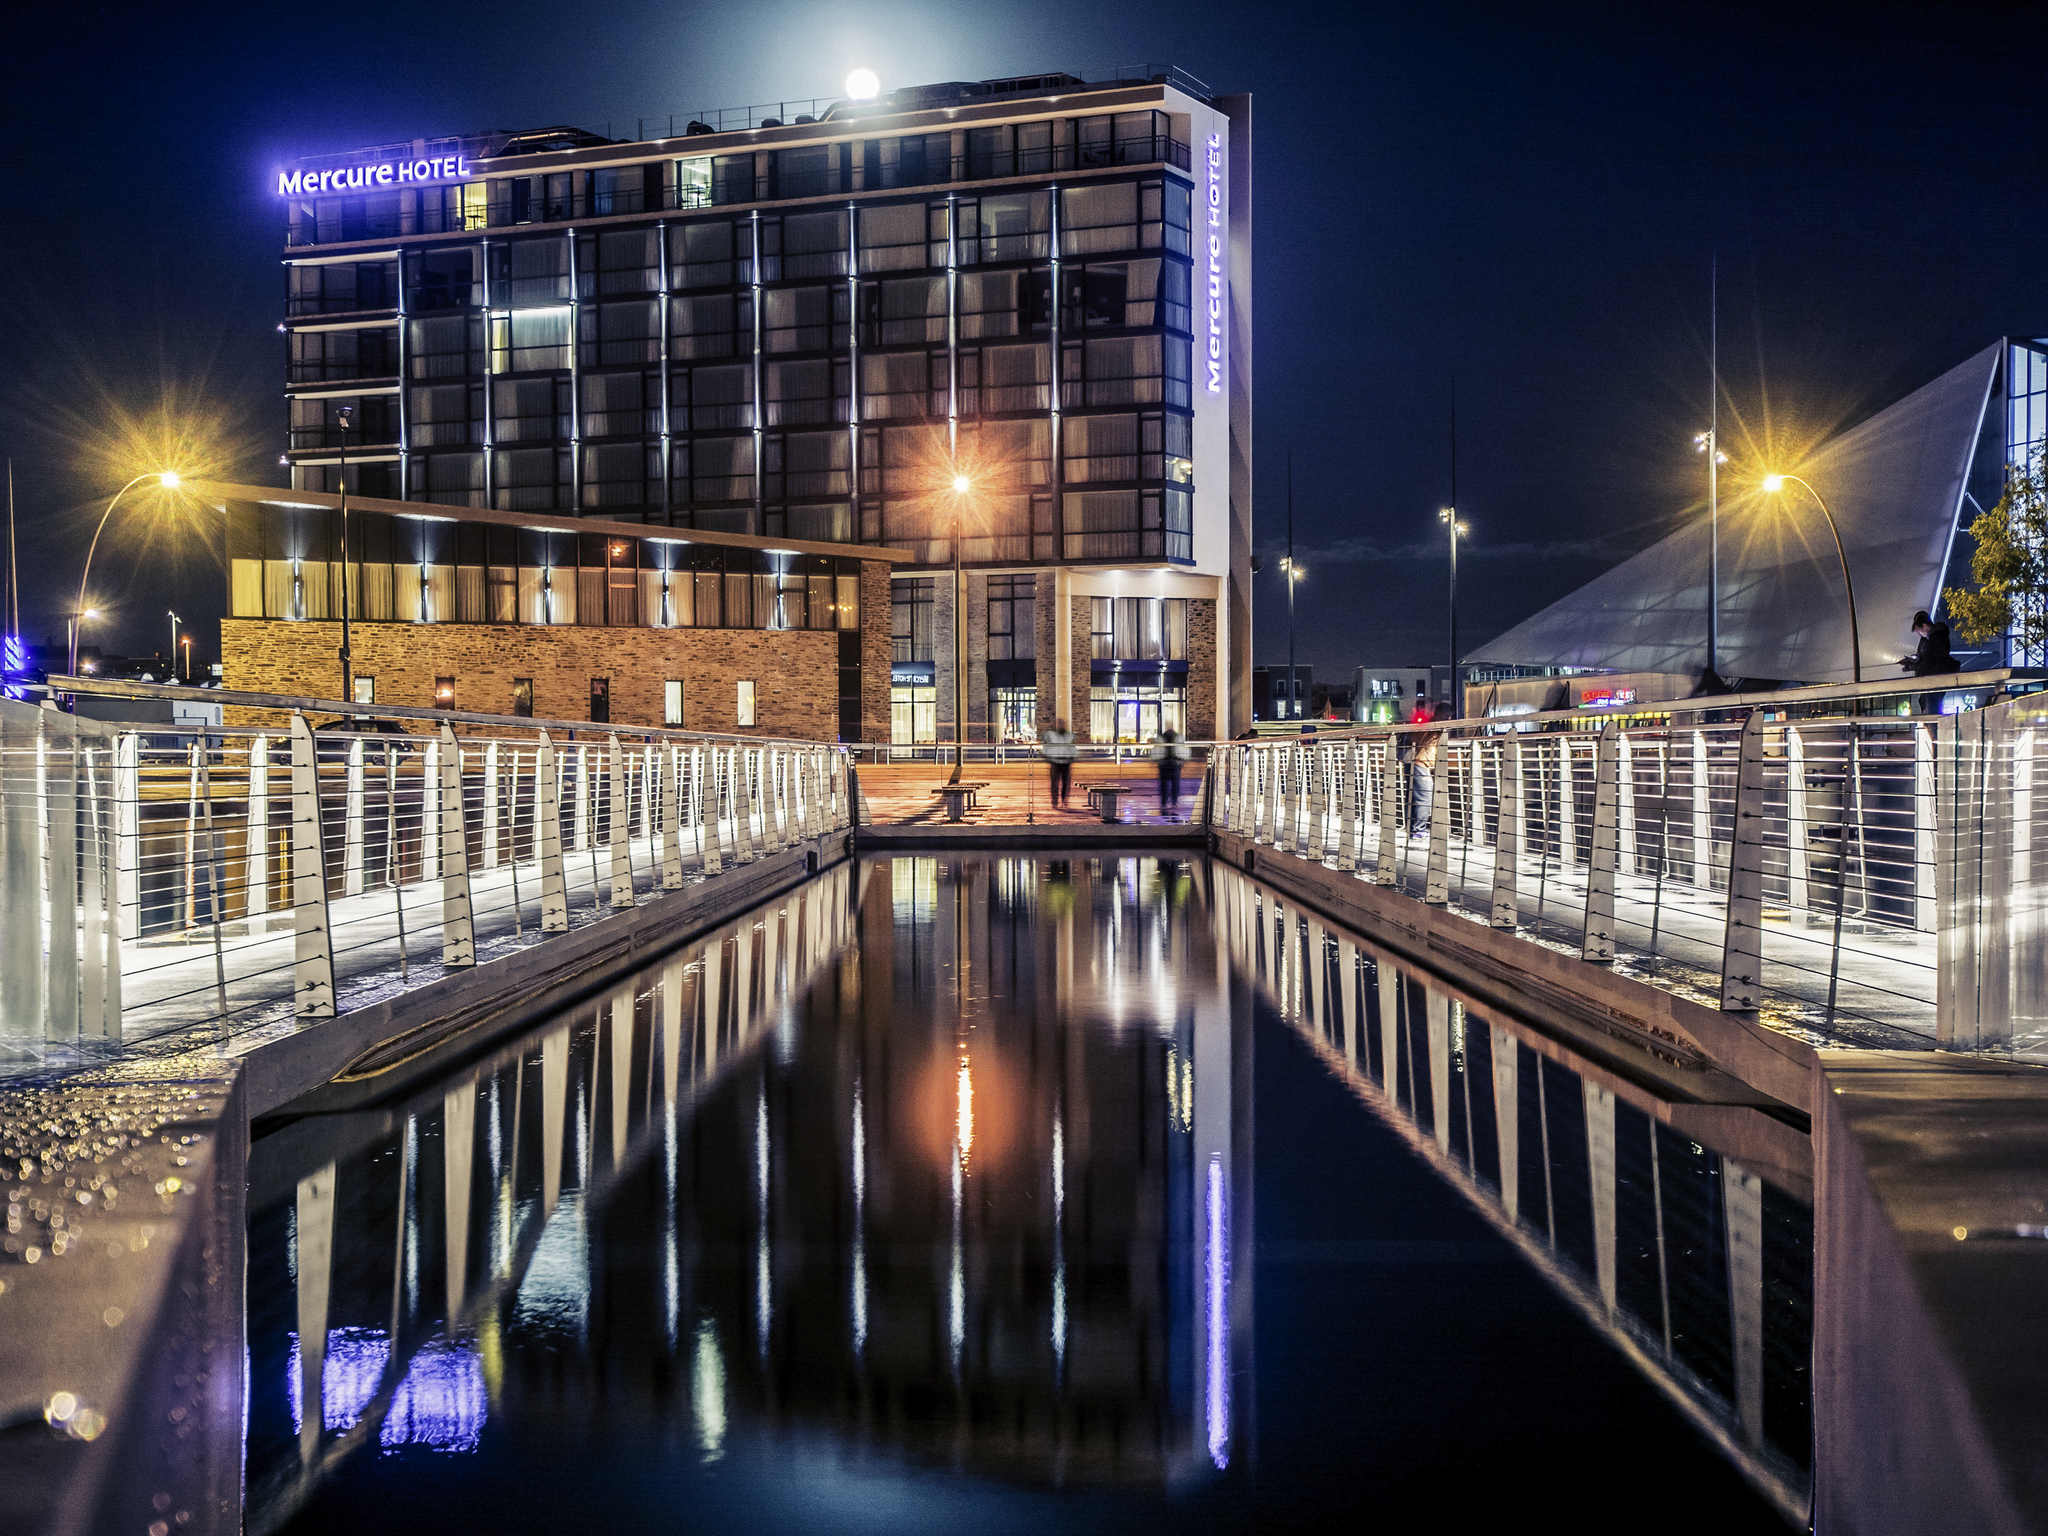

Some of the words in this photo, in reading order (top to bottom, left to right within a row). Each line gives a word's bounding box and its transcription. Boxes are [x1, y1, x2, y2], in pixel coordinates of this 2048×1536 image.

[278, 163, 393, 195] Mercure
[400, 156, 470, 182] HOTEL
[1206, 132, 1221, 227] HOTEL
[1207, 234, 1222, 393] Mercure
